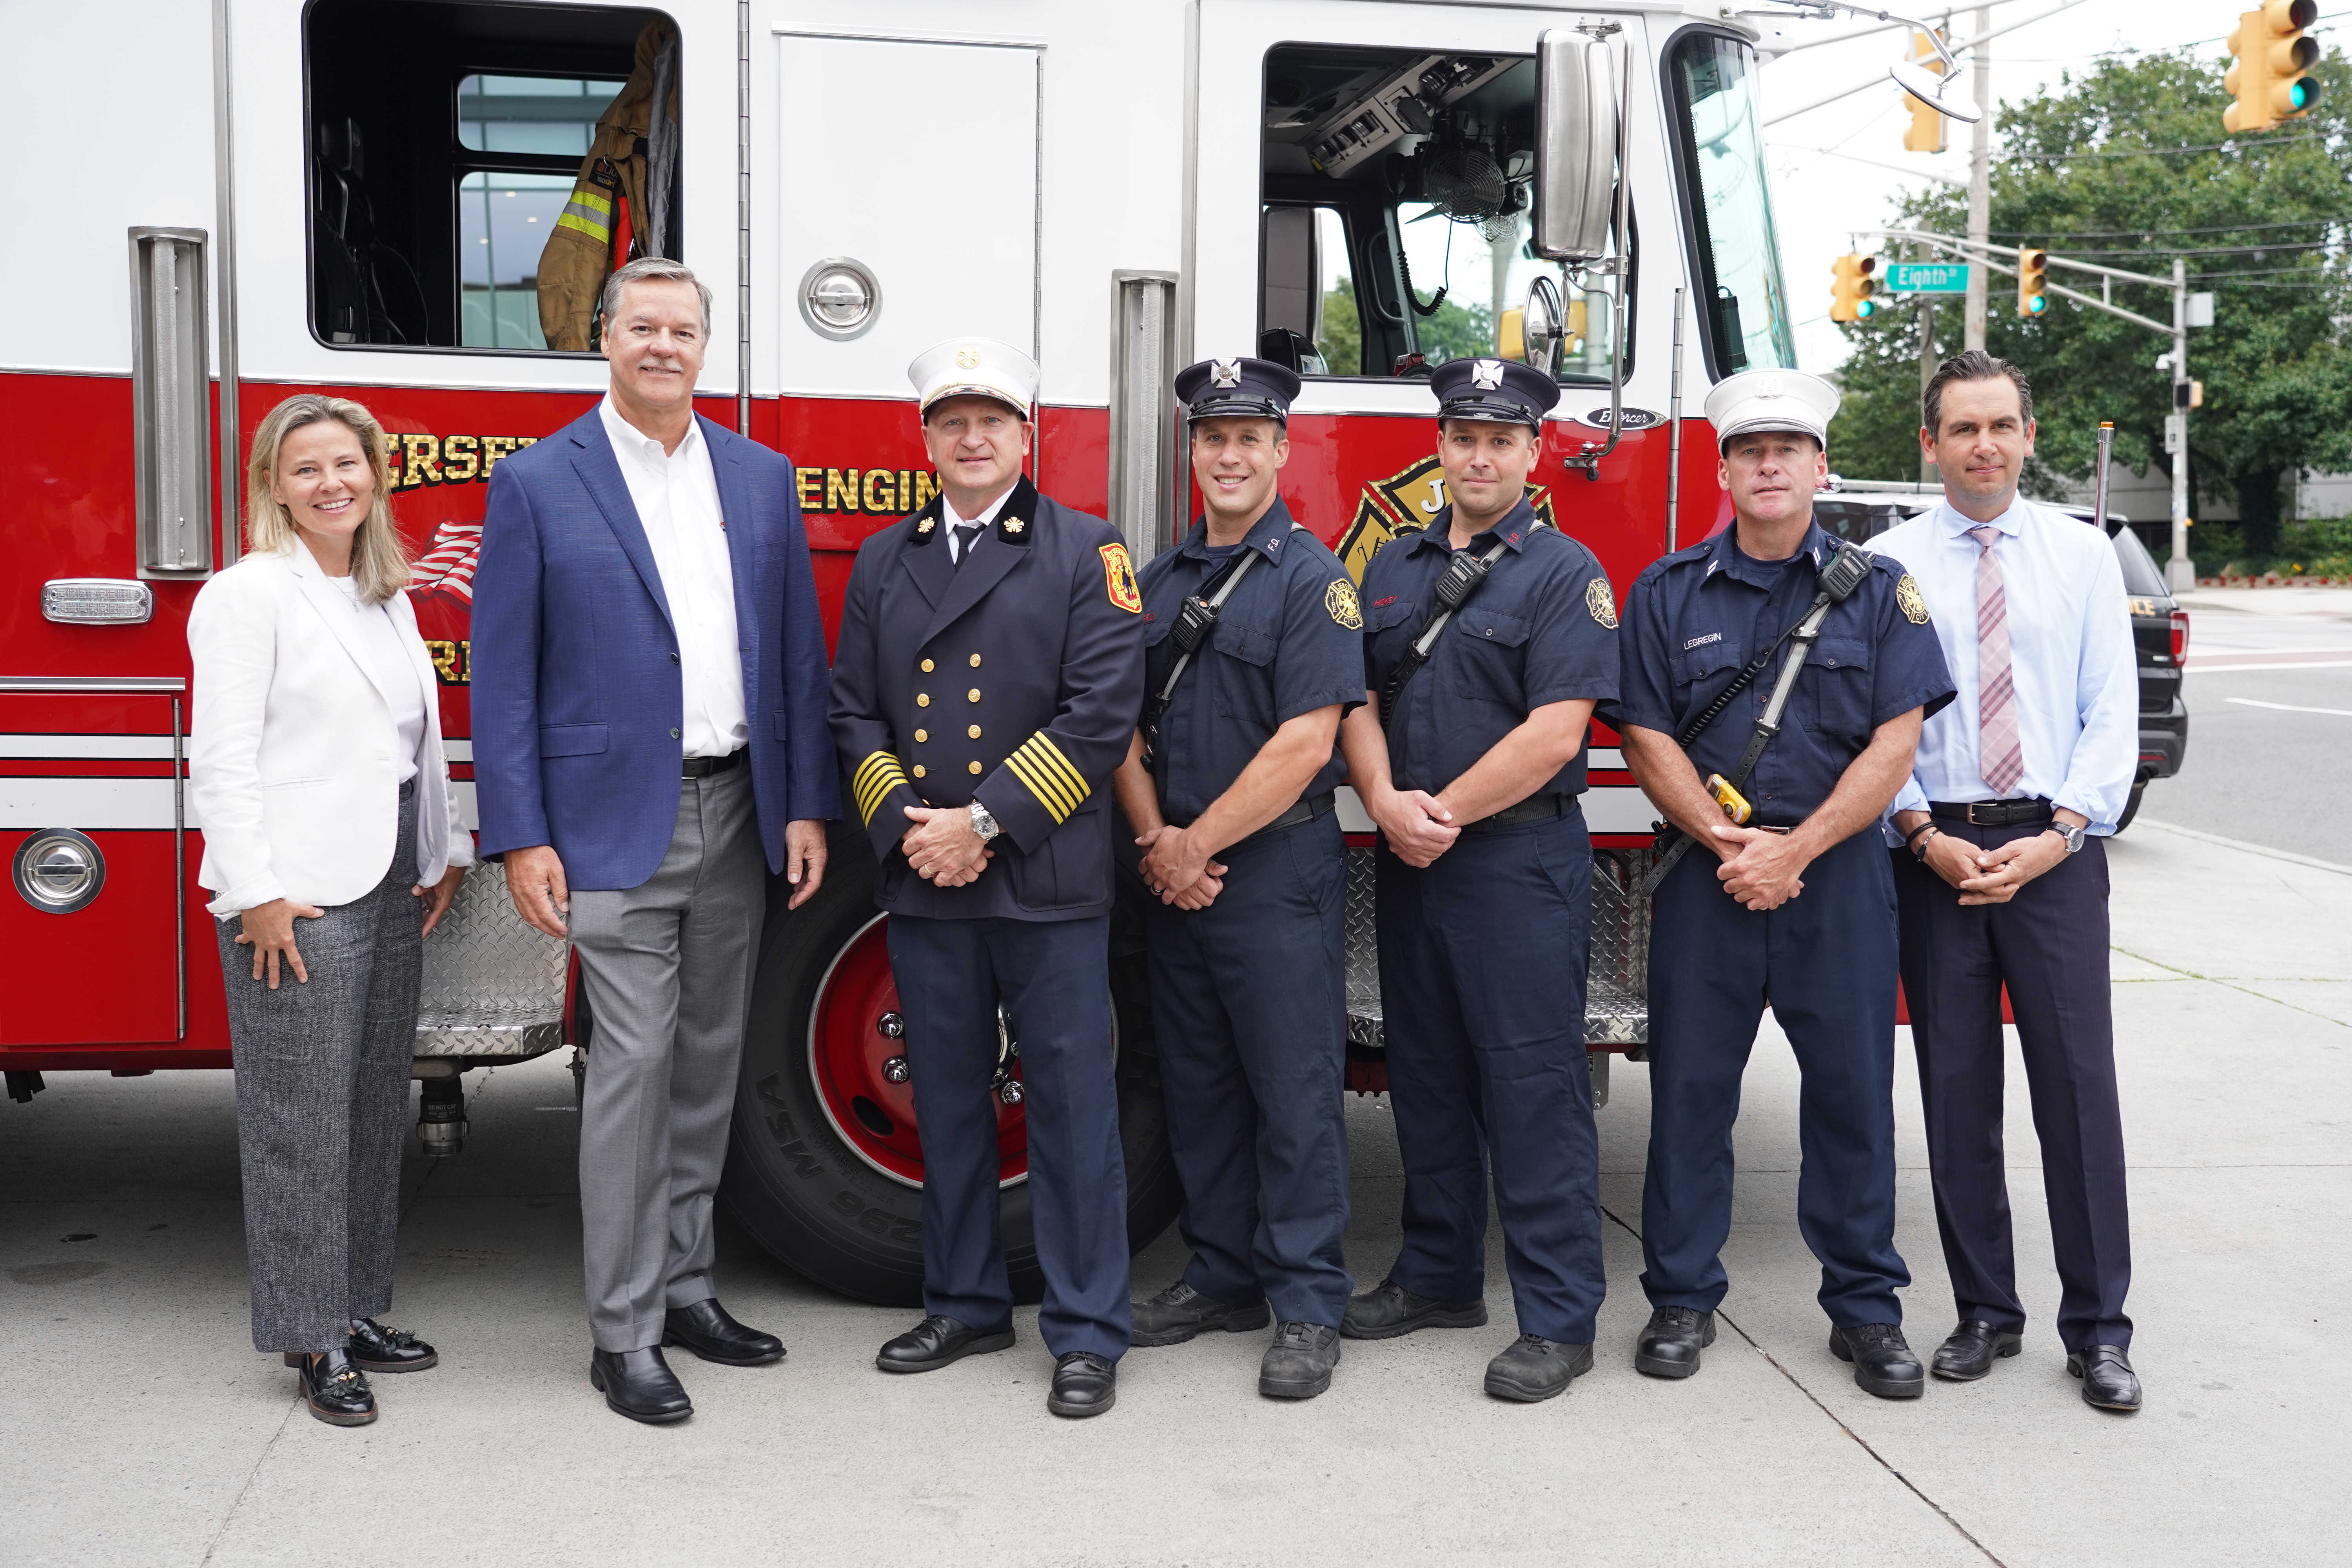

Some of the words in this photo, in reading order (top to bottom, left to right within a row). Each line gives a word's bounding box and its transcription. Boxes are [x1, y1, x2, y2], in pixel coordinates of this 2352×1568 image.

[1898, 267, 1947, 290] Eighth
[1599, 411, 1649, 426] Eorcer
[385, 434, 545, 489] ERSE
[796, 467, 942, 511] ENGIN
[1421, 478, 1445, 513] J
[1267, 538, 1280, 552] F.D.
[1508, 533, 1521, 544] F.D.
[1108, 548, 1122, 560] JERSEY
[1111, 557, 1120, 567] FIRE
[1459, 562, 1474, 576] MOTOROLA
[1851, 556, 1866, 570] MOTOROLA
[1113, 584, 1123, 599] DUTY
[1373, 595, 1398, 607] HICKEY
[1898, 593, 1911, 614] FIRE
[1189, 610, 1203, 624] MOTOROLA
[1343, 617, 1358, 625] CITY
[1601, 615, 1614, 625] CITY
[1916, 610, 1928, 621] CITY
[1683, 632, 1721, 650] LEGREGIN
[755, 1071, 825, 1180] MSA
[835, 1162, 895, 1207] UNISTEEL
[828, 1189, 922, 1244] 296
